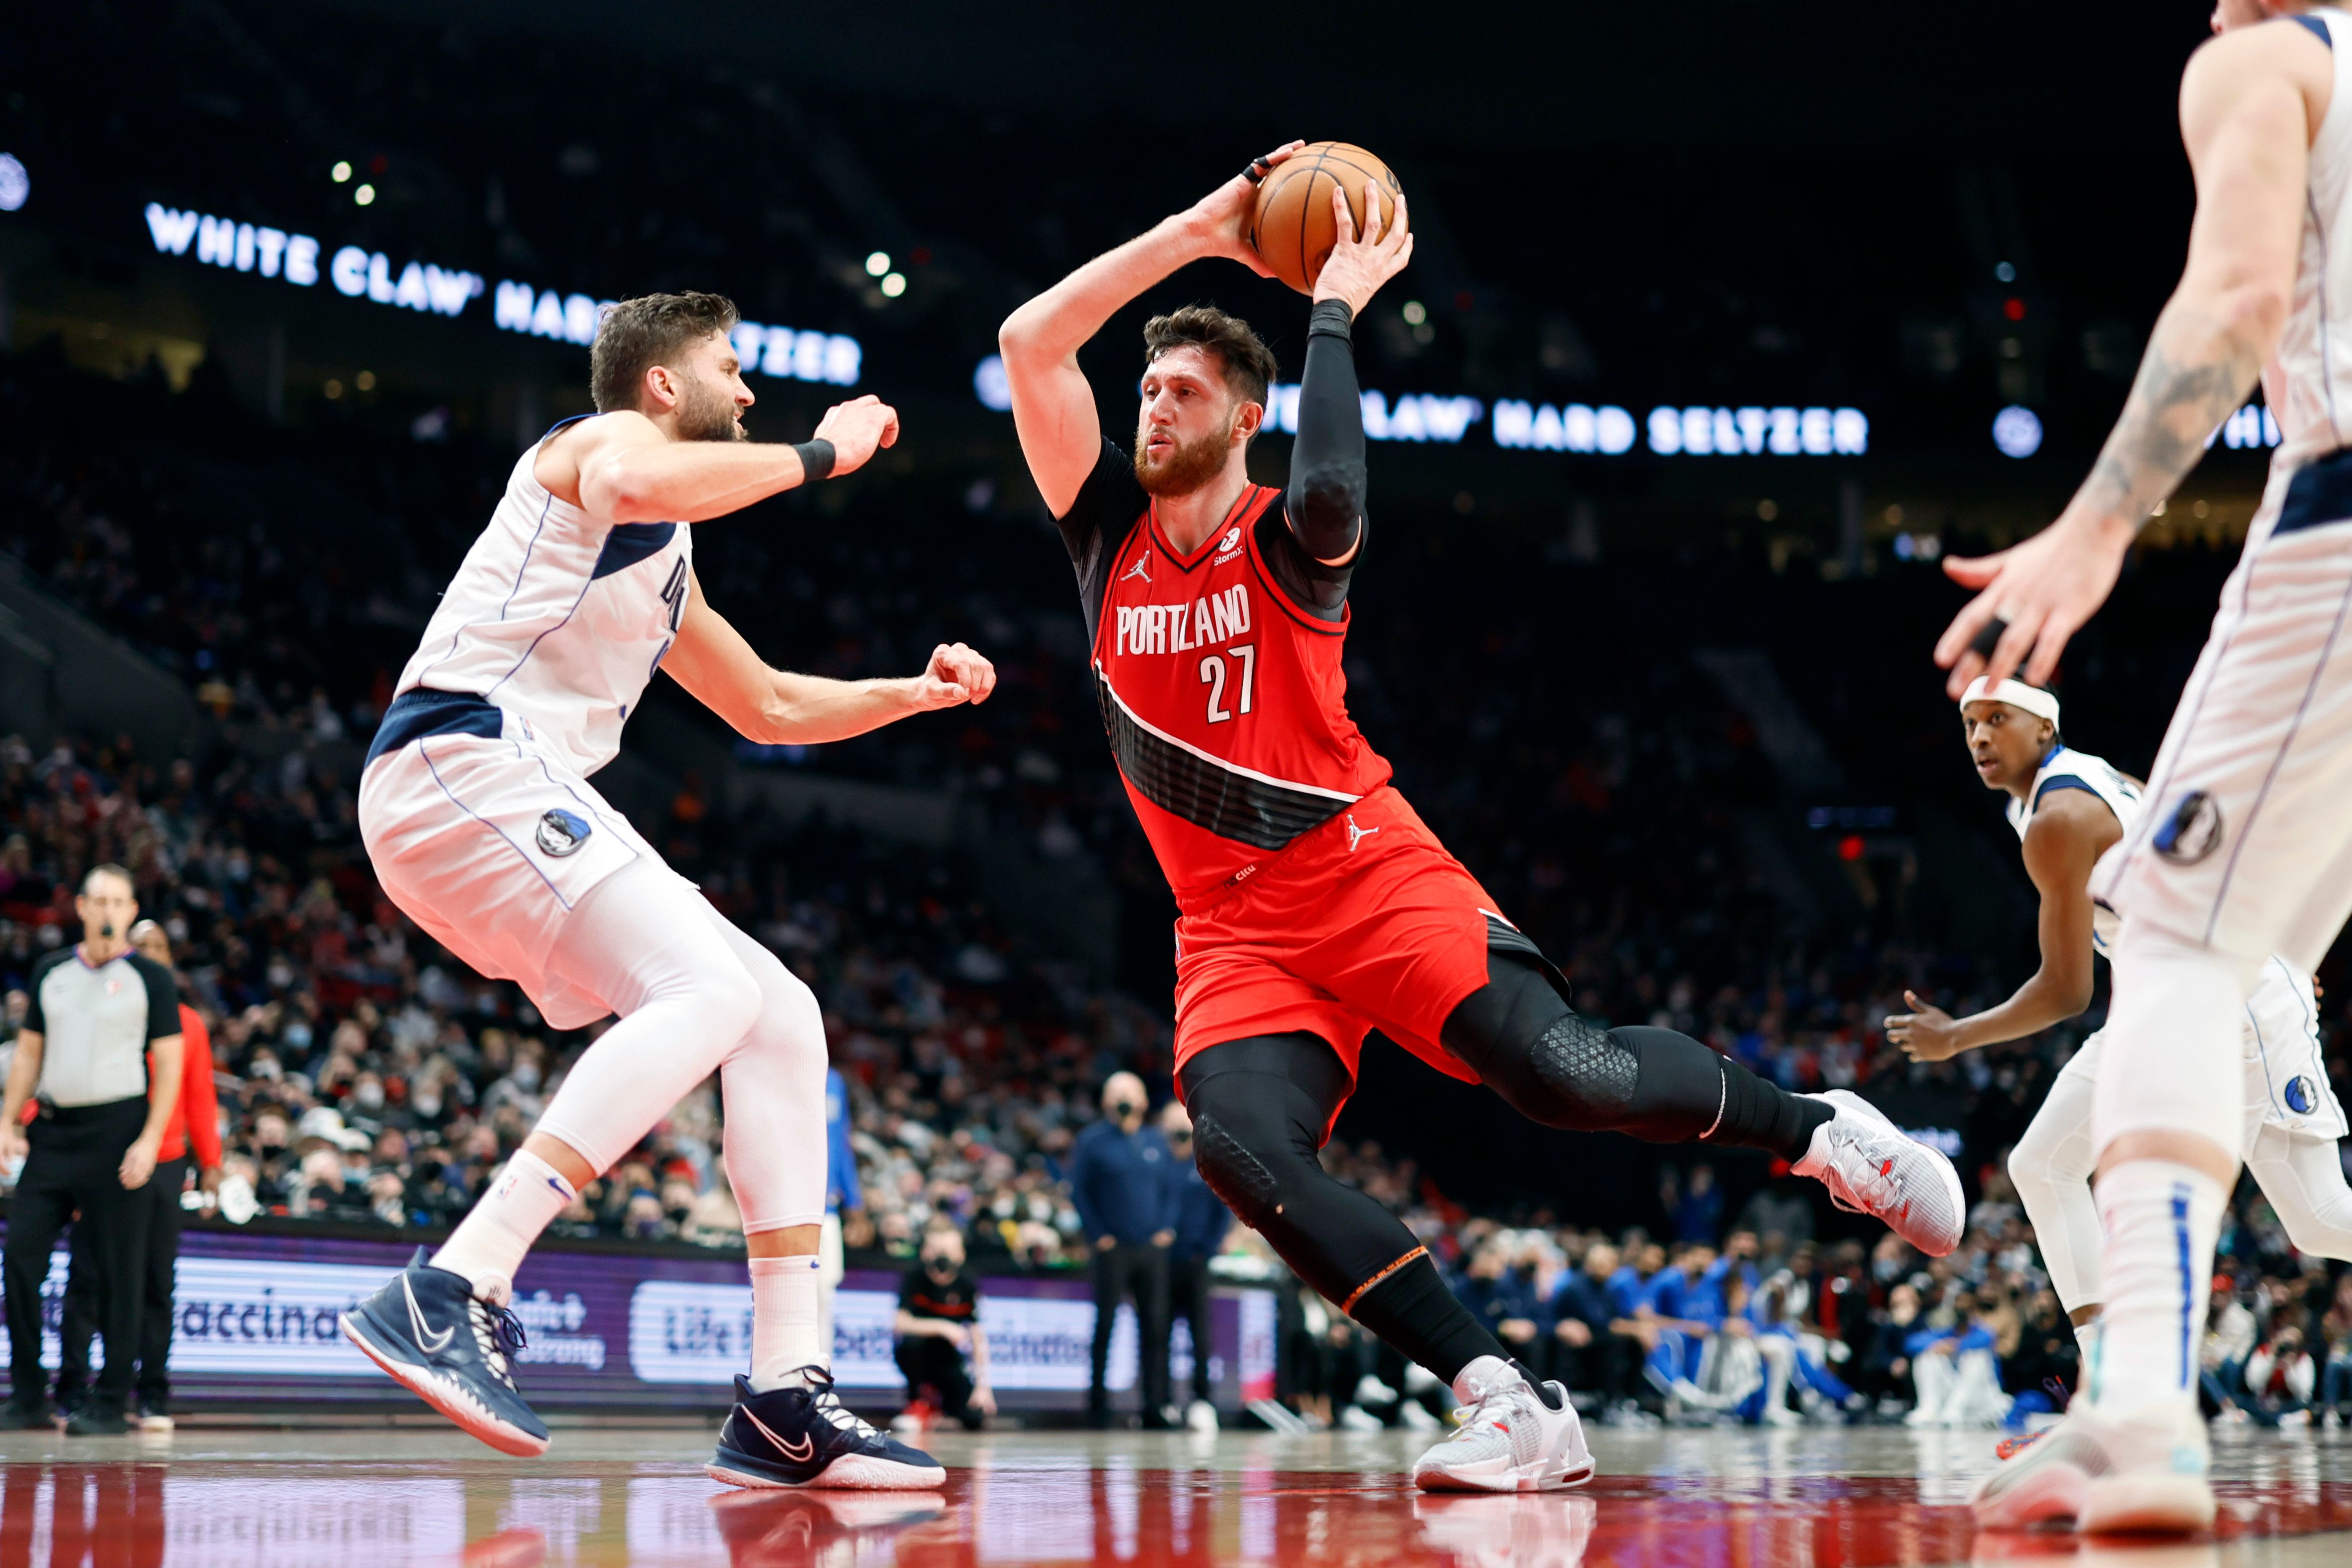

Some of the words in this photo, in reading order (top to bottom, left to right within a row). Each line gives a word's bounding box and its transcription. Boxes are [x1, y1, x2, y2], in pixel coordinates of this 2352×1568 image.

[146, 201, 320, 286] WHITE
[331, 246, 478, 317] CLAW
[495, 279, 617, 347] HAR
[732, 319, 862, 385] TZER
[1359, 389, 1475, 443] LAW
[1493, 399, 1636, 455] HARD
[1647, 406, 1869, 455] SELTZER
[1214, 545, 1243, 567] StormX
[1116, 584, 1251, 656] PORTLAND
[1199, 644, 1255, 724] 27
